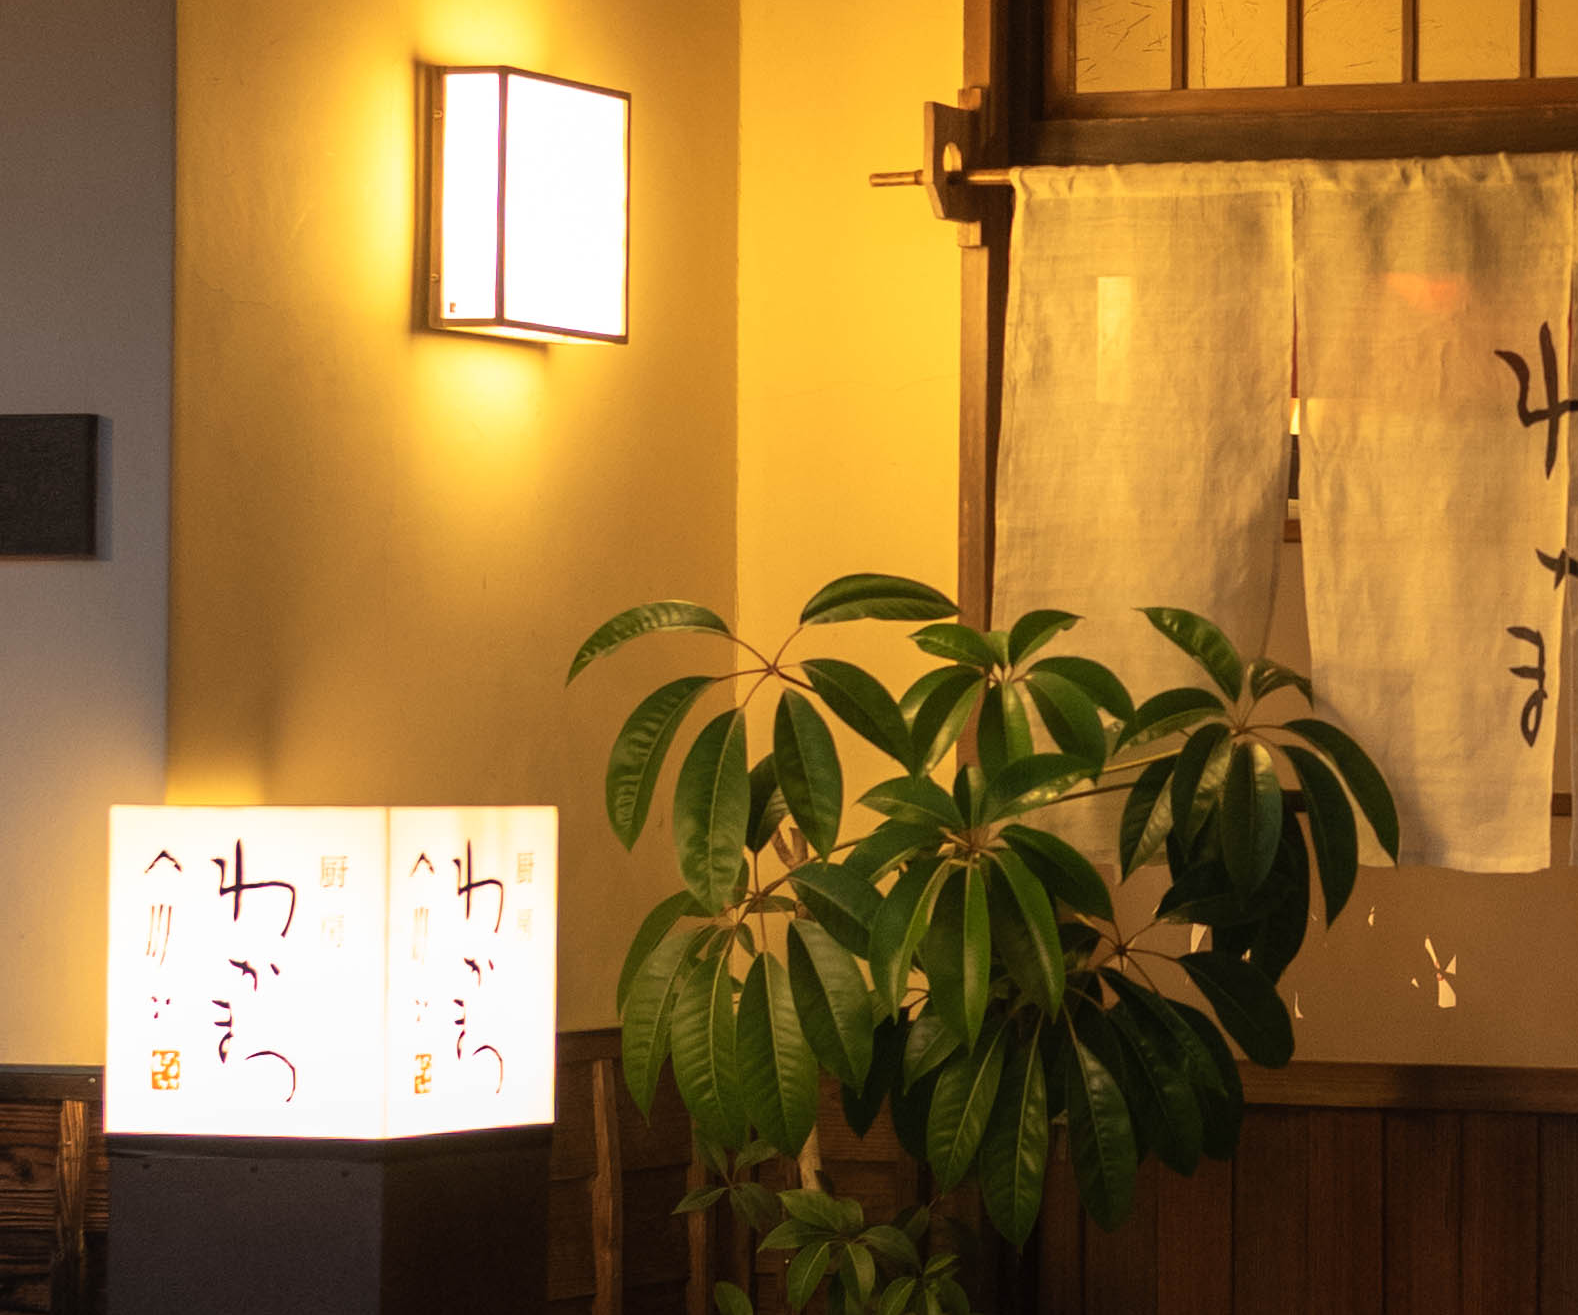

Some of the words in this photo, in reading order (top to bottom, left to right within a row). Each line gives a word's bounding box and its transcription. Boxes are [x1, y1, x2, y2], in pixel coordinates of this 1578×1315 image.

[210, 837, 297, 1103] わかまつ
[452, 837, 505, 1095] わかまつ
